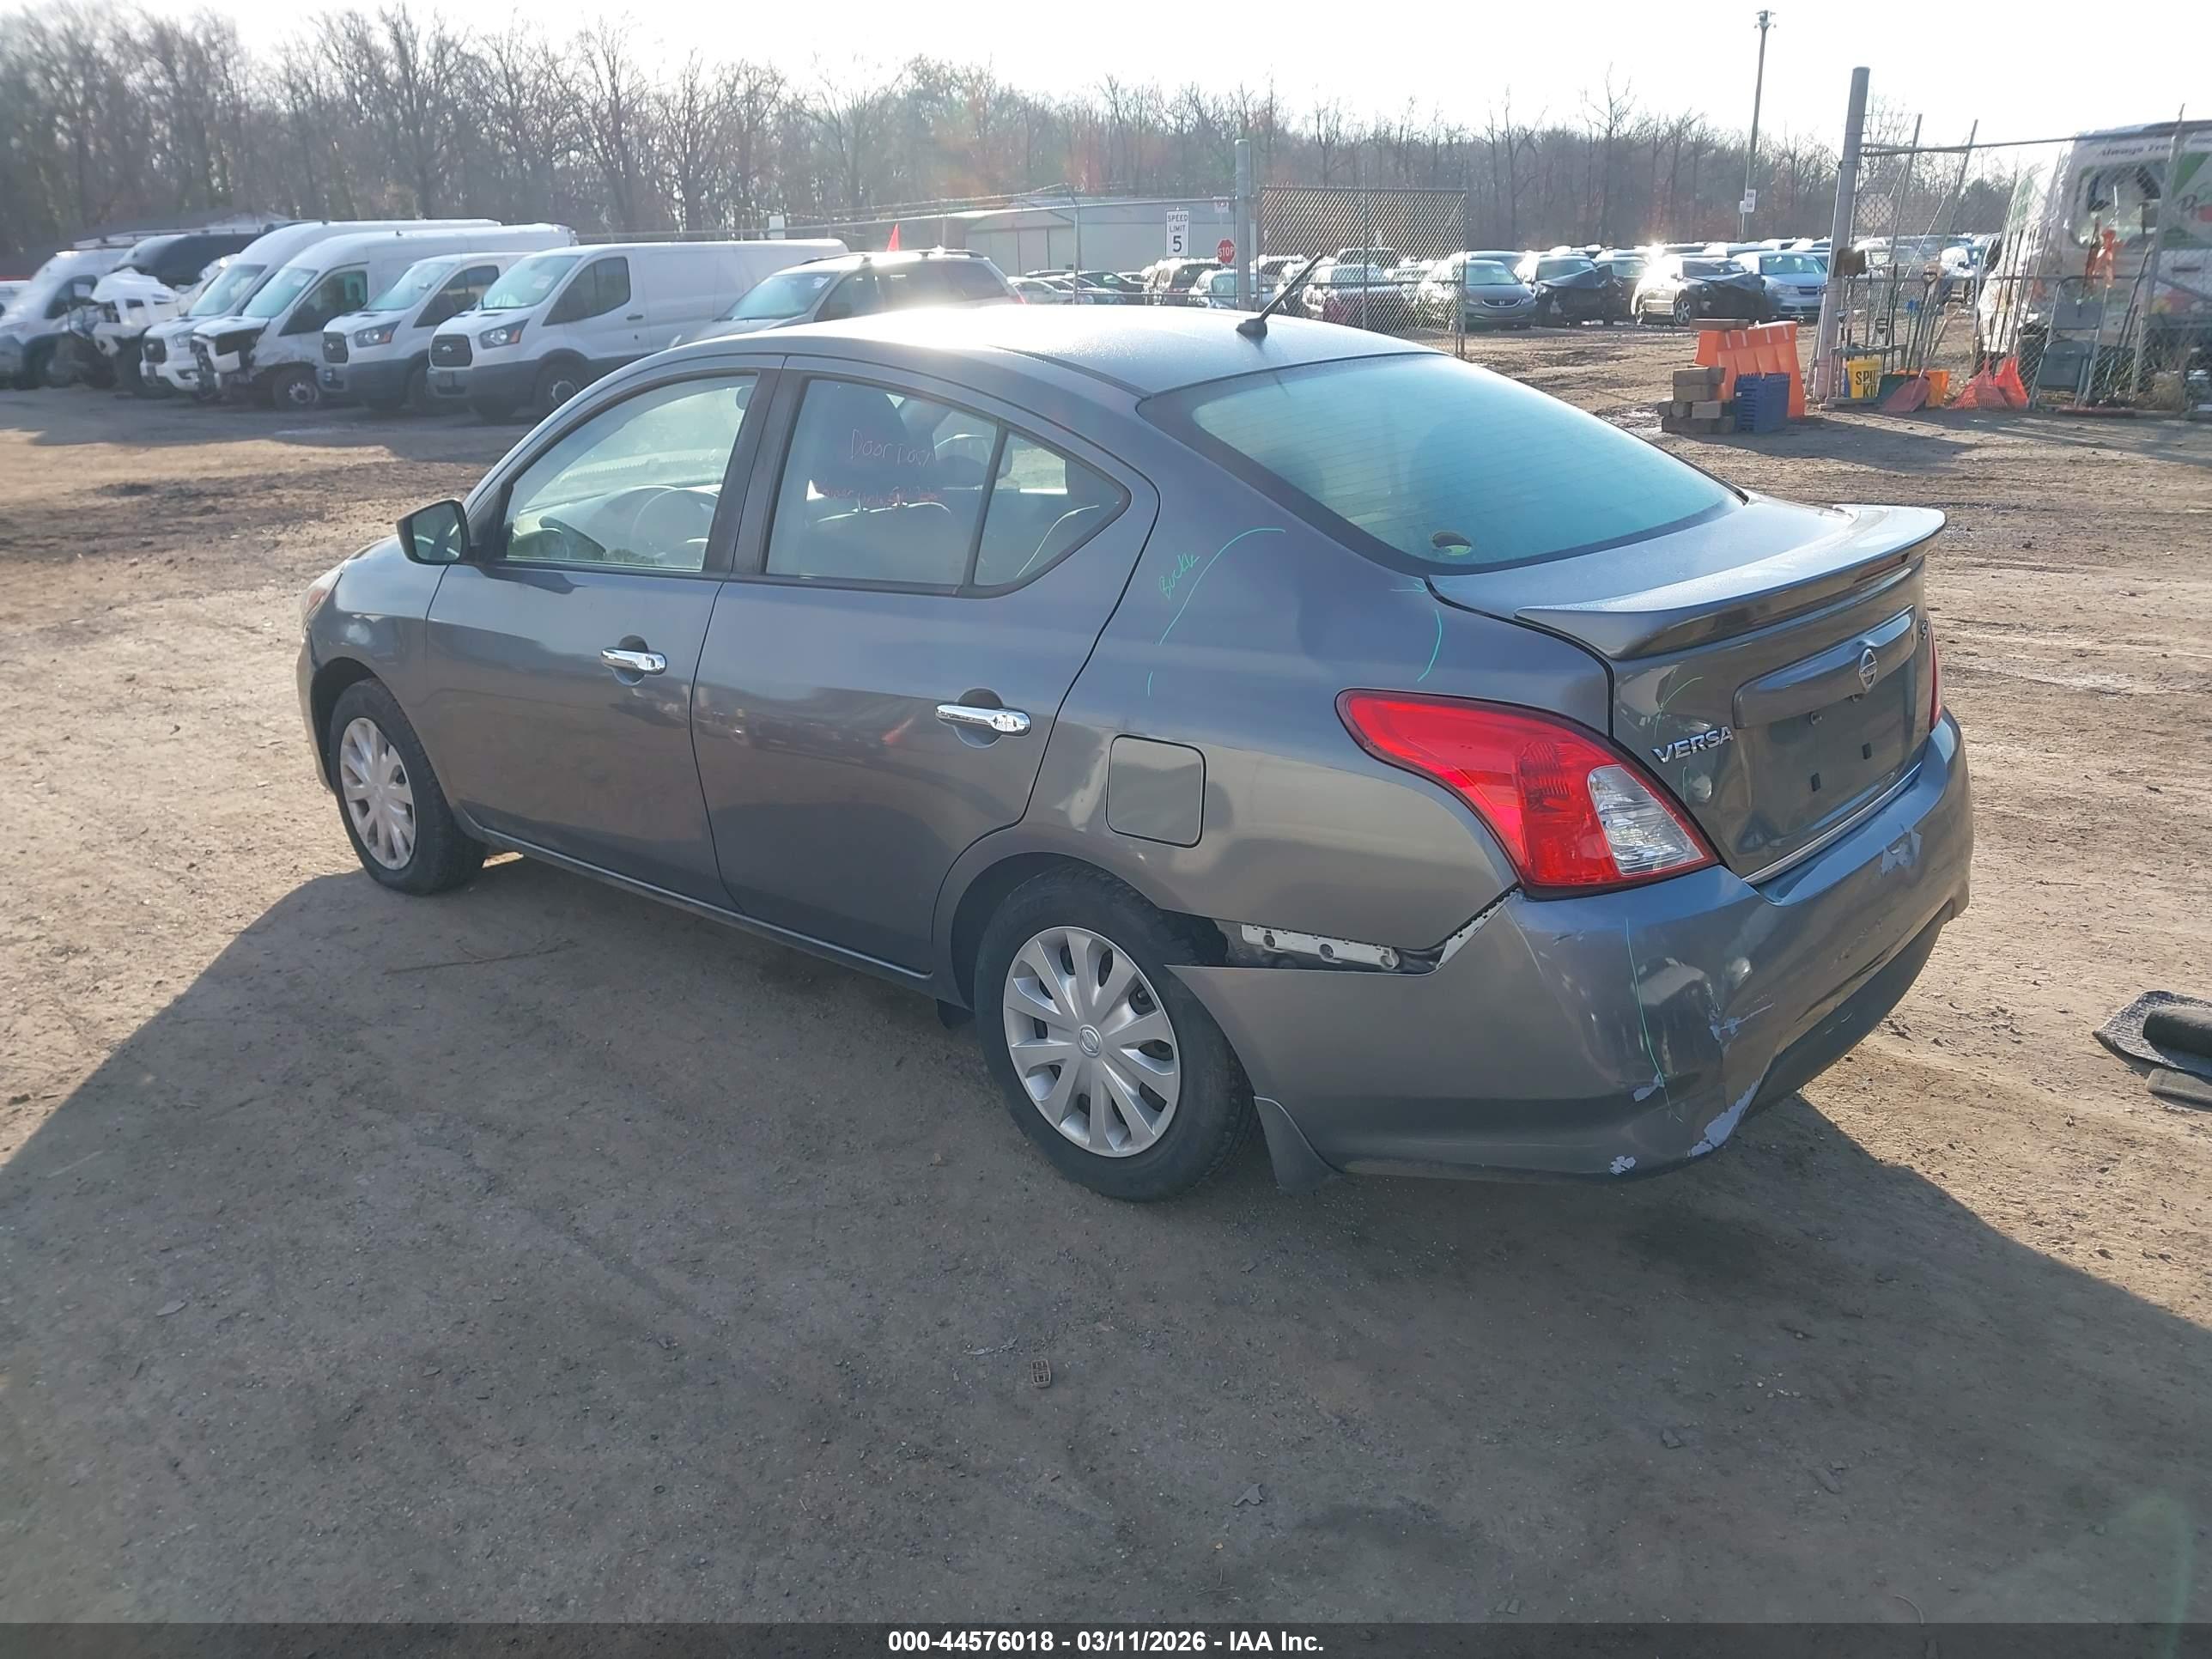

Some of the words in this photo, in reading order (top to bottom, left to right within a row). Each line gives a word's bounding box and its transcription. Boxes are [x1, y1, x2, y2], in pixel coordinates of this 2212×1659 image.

[1168, 214, 1188, 222] SPEED
[1170, 224, 1186, 233] LIMIT
[1173, 235, 1182, 252] 5
[1218, 246, 1234, 257] STOP
[1651, 726, 1734, 763] VERSA
